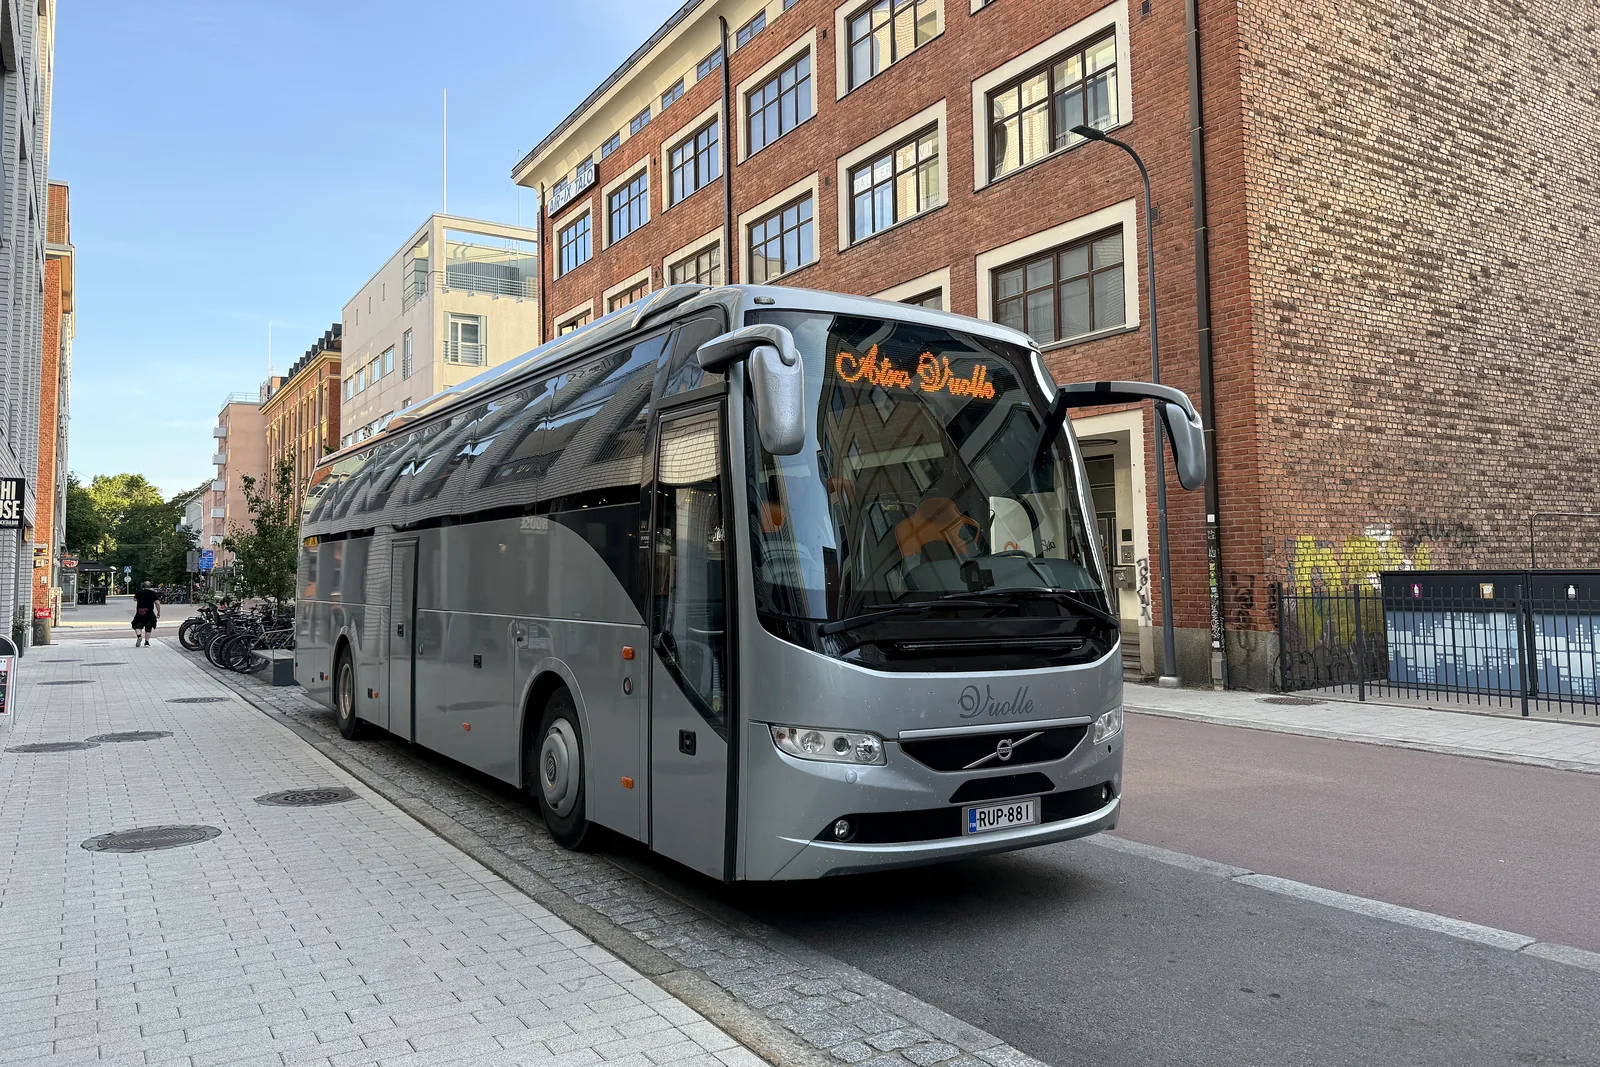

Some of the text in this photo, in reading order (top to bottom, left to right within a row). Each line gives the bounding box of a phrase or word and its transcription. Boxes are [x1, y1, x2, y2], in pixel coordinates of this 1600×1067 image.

[549, 168, 593, 215] AIR-IX TALO
[957, 684, 1034, 719] Vuolle
[979, 804, 1029, 828] RUP-881
